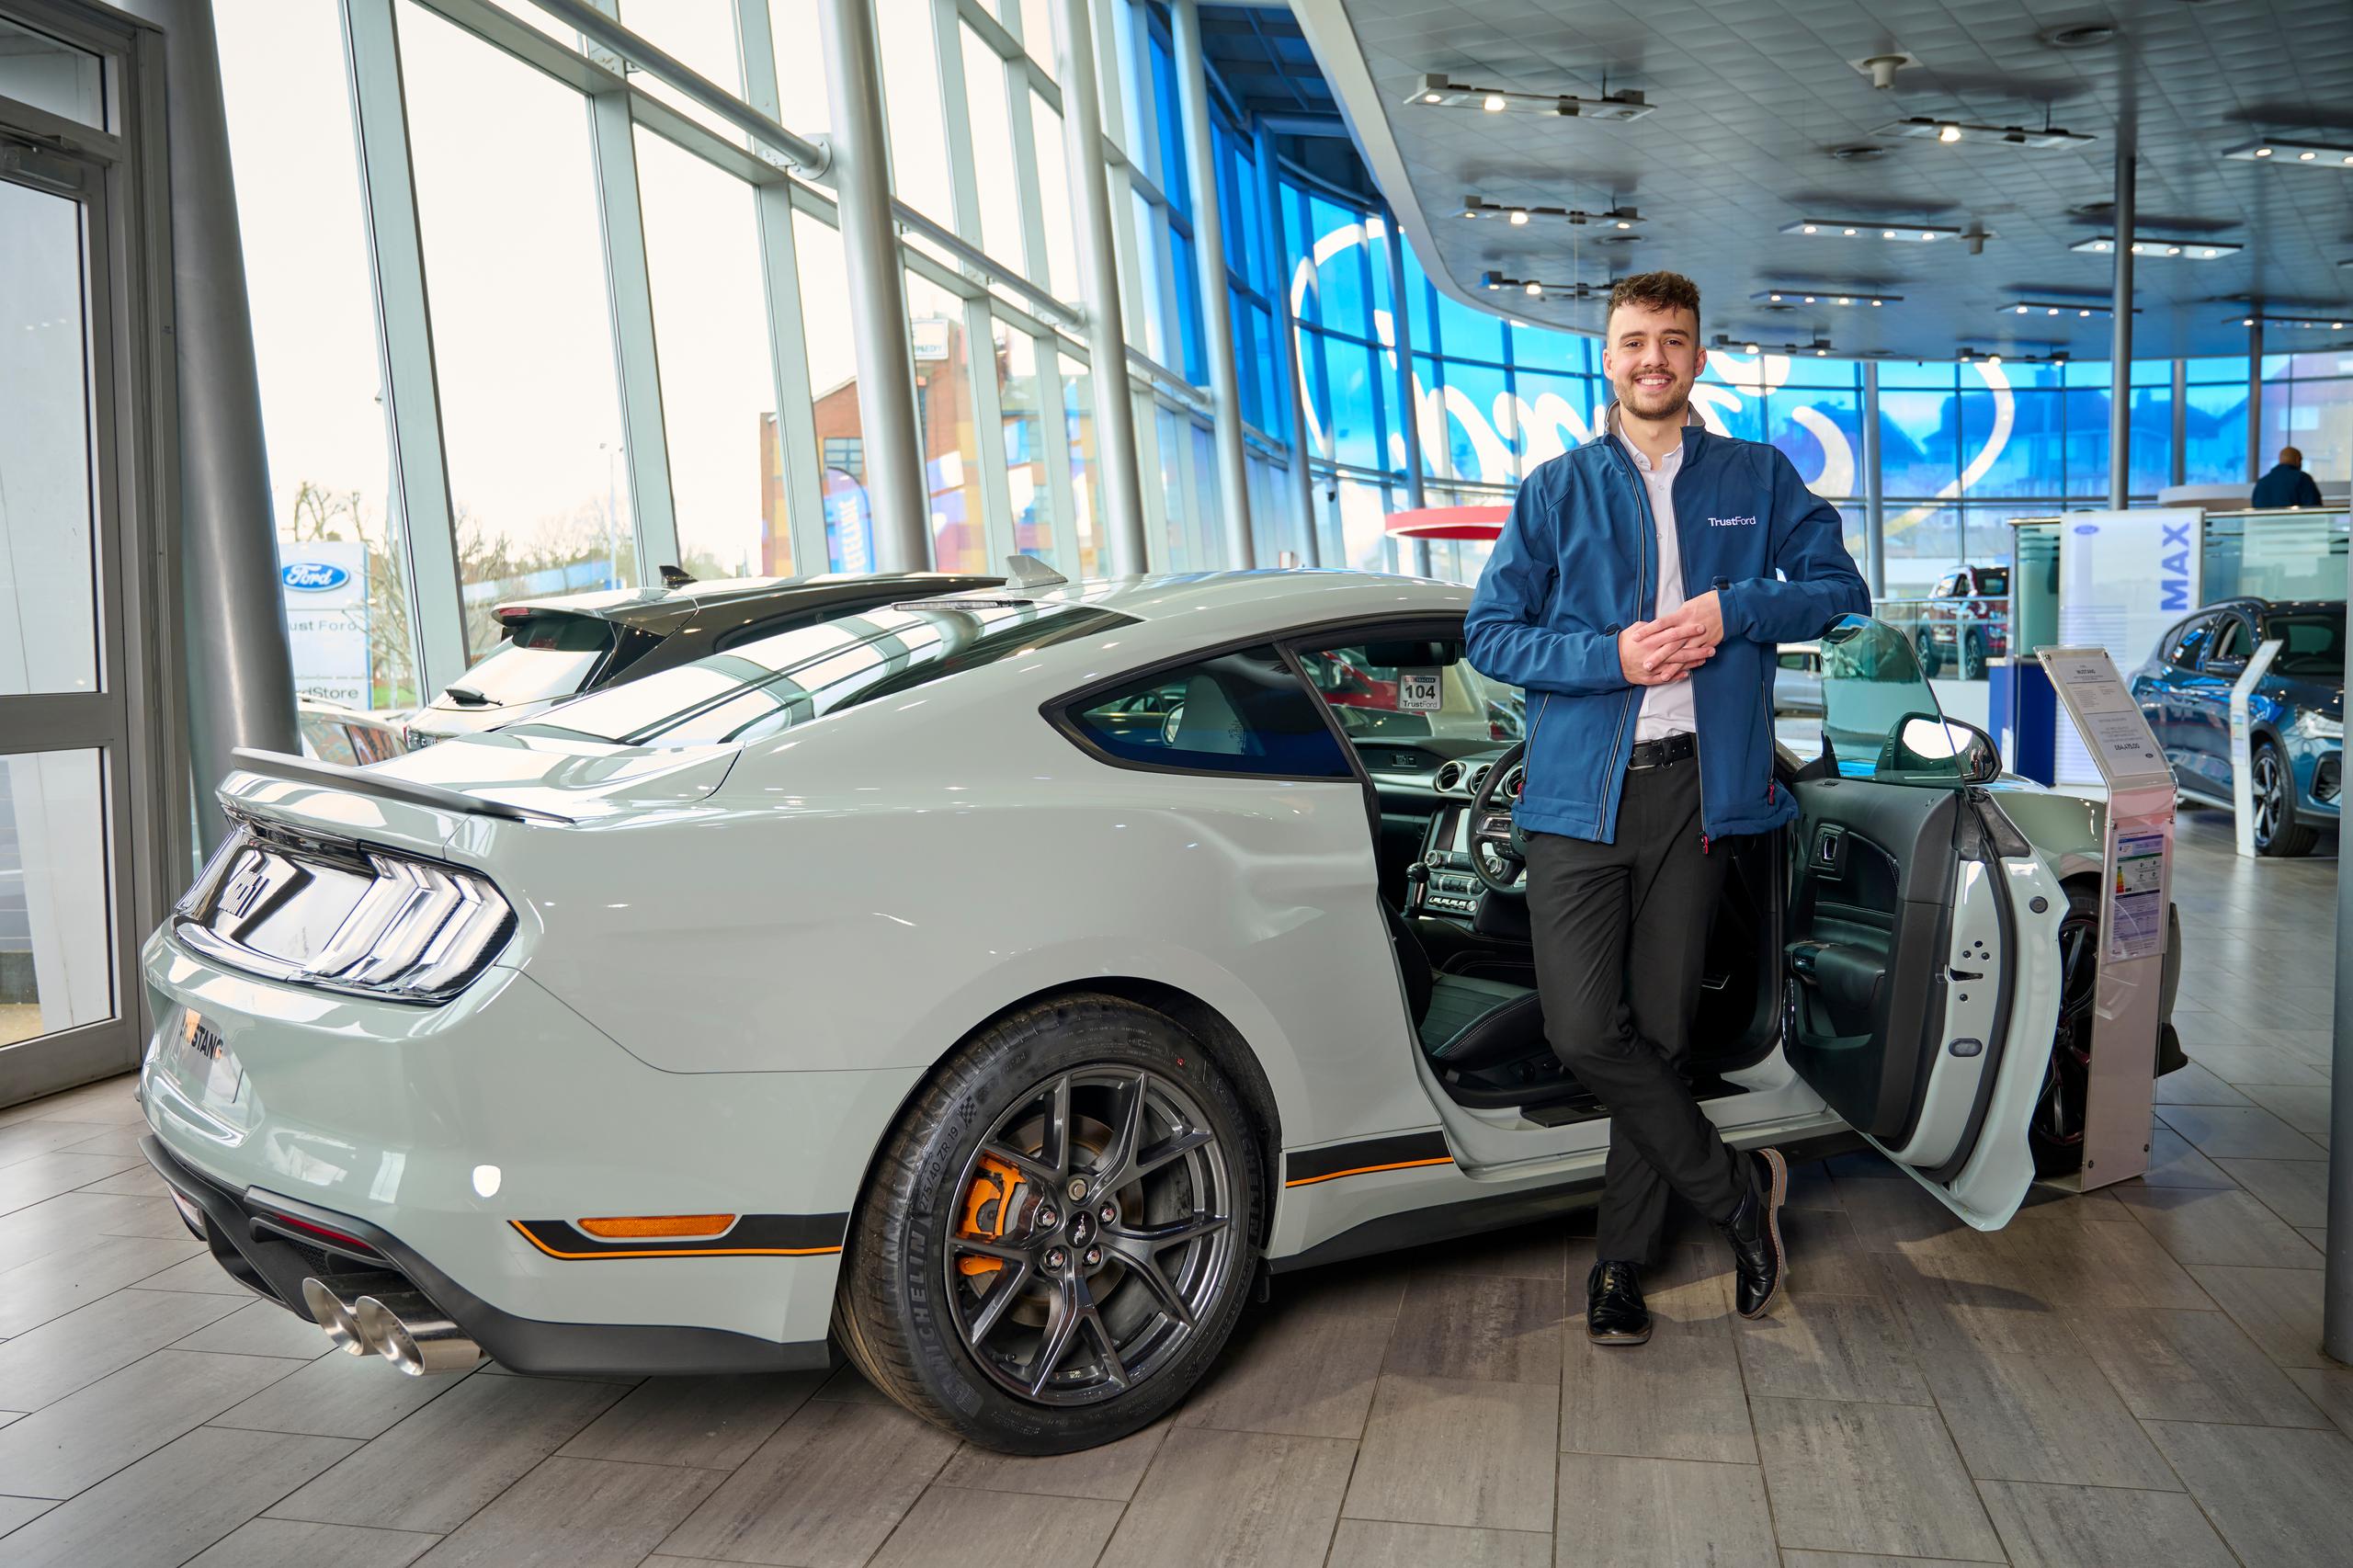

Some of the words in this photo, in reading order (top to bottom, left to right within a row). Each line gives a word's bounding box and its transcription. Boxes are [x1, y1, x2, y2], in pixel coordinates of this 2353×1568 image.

[1708, 516, 1756, 528] TrustFord
[286, 564, 333, 585] Ford
[2160, 522, 2189, 610] MAX
[290, 621, 313, 631] ust
[1404, 685, 1435, 699] 104
[180, 1020, 223, 1060] STANG
[920, 1162, 941, 1210] 275/40
[938, 1142, 950, 1161] ZR
[948, 1126, 959, 1141] 19
[909, 1229, 948, 1374] MICHELIN
